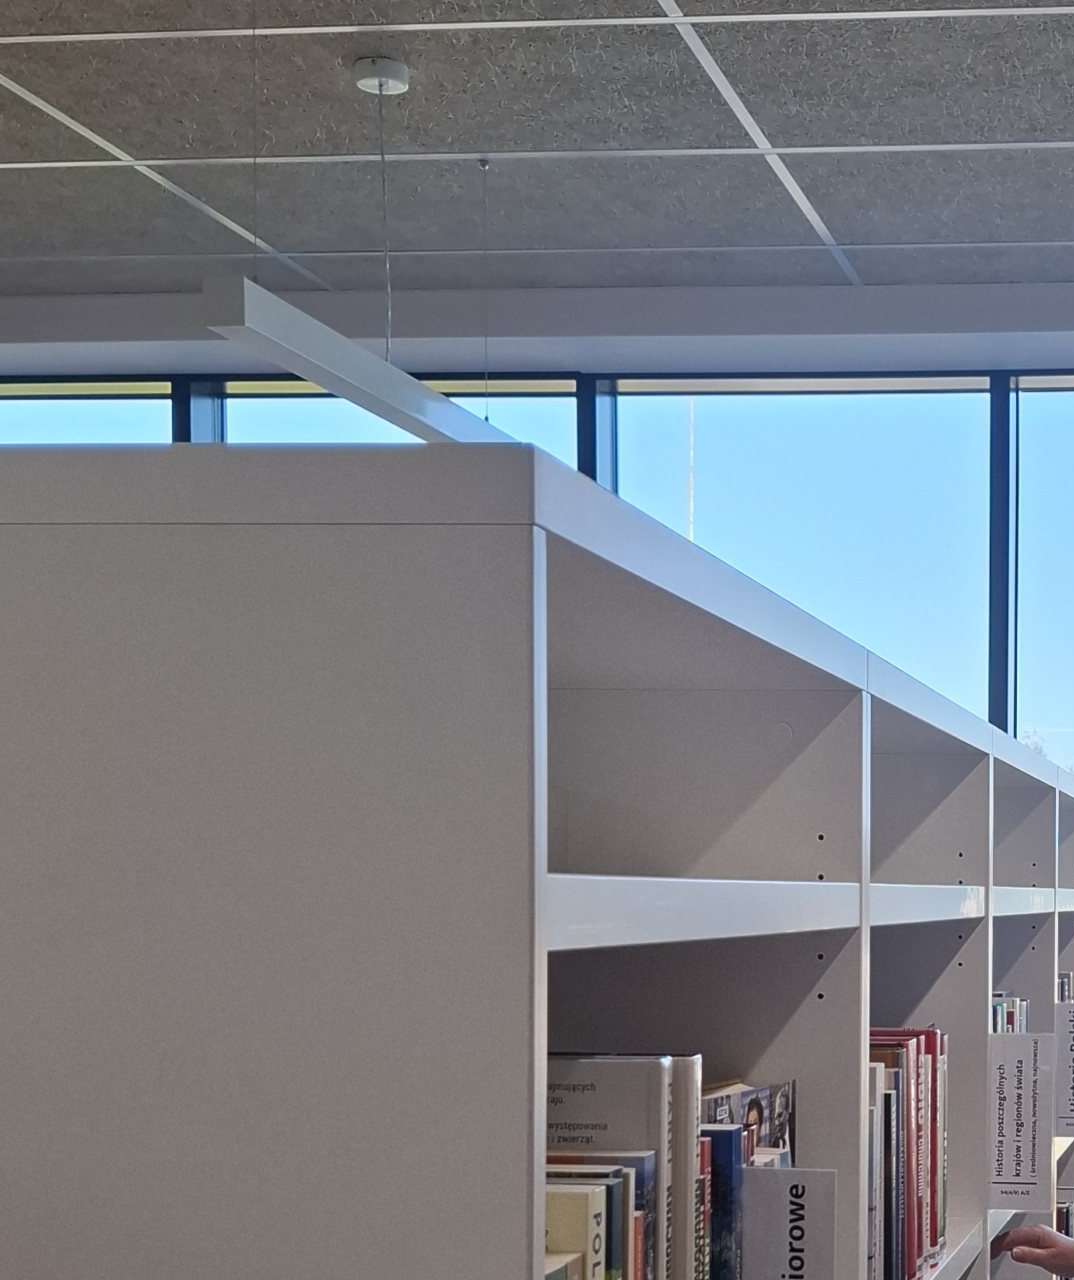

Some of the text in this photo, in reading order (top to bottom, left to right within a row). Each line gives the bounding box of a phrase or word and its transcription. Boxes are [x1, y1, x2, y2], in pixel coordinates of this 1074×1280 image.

[1014, 1060, 1023, 1091] świata
[995, 1064, 1007, 1178] Historia poszczególnych
[1013, 1092, 1024, 1138] regionów
[1013, 1145, 1024, 1178] krajów
